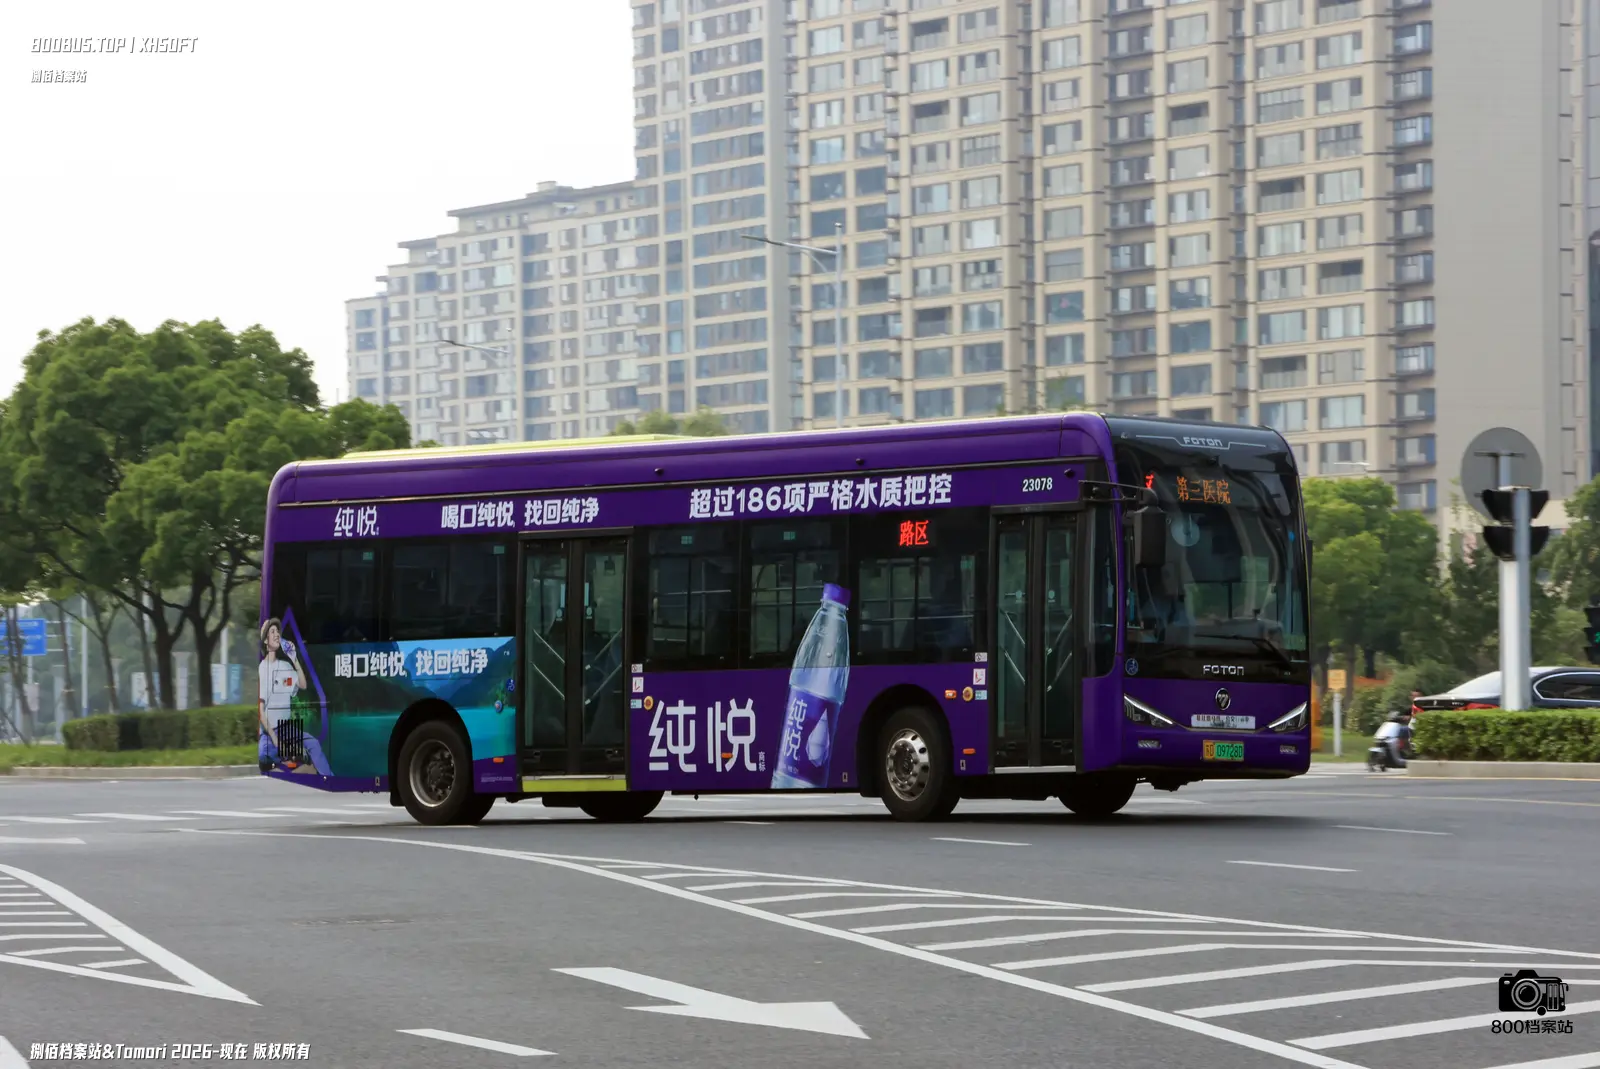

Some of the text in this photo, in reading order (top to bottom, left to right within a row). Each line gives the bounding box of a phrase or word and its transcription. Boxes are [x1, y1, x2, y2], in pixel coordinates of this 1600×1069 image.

[1183, 436, 1223, 447] FOTON
[689, 473, 952, 519] 超过186项严格水质把控
[1022, 477, 1053, 492] 23078
[333, 505, 377, 537] 纯悦
[524, 497, 599, 526] 找回纯净
[899, 520, 929, 546] 路区
[416, 648, 488, 676] 找回纯净
[1203, 664, 1244, 676] FOTON
[648, 698, 757, 773] 纯悦
[782, 696, 808, 761] 纯悦
